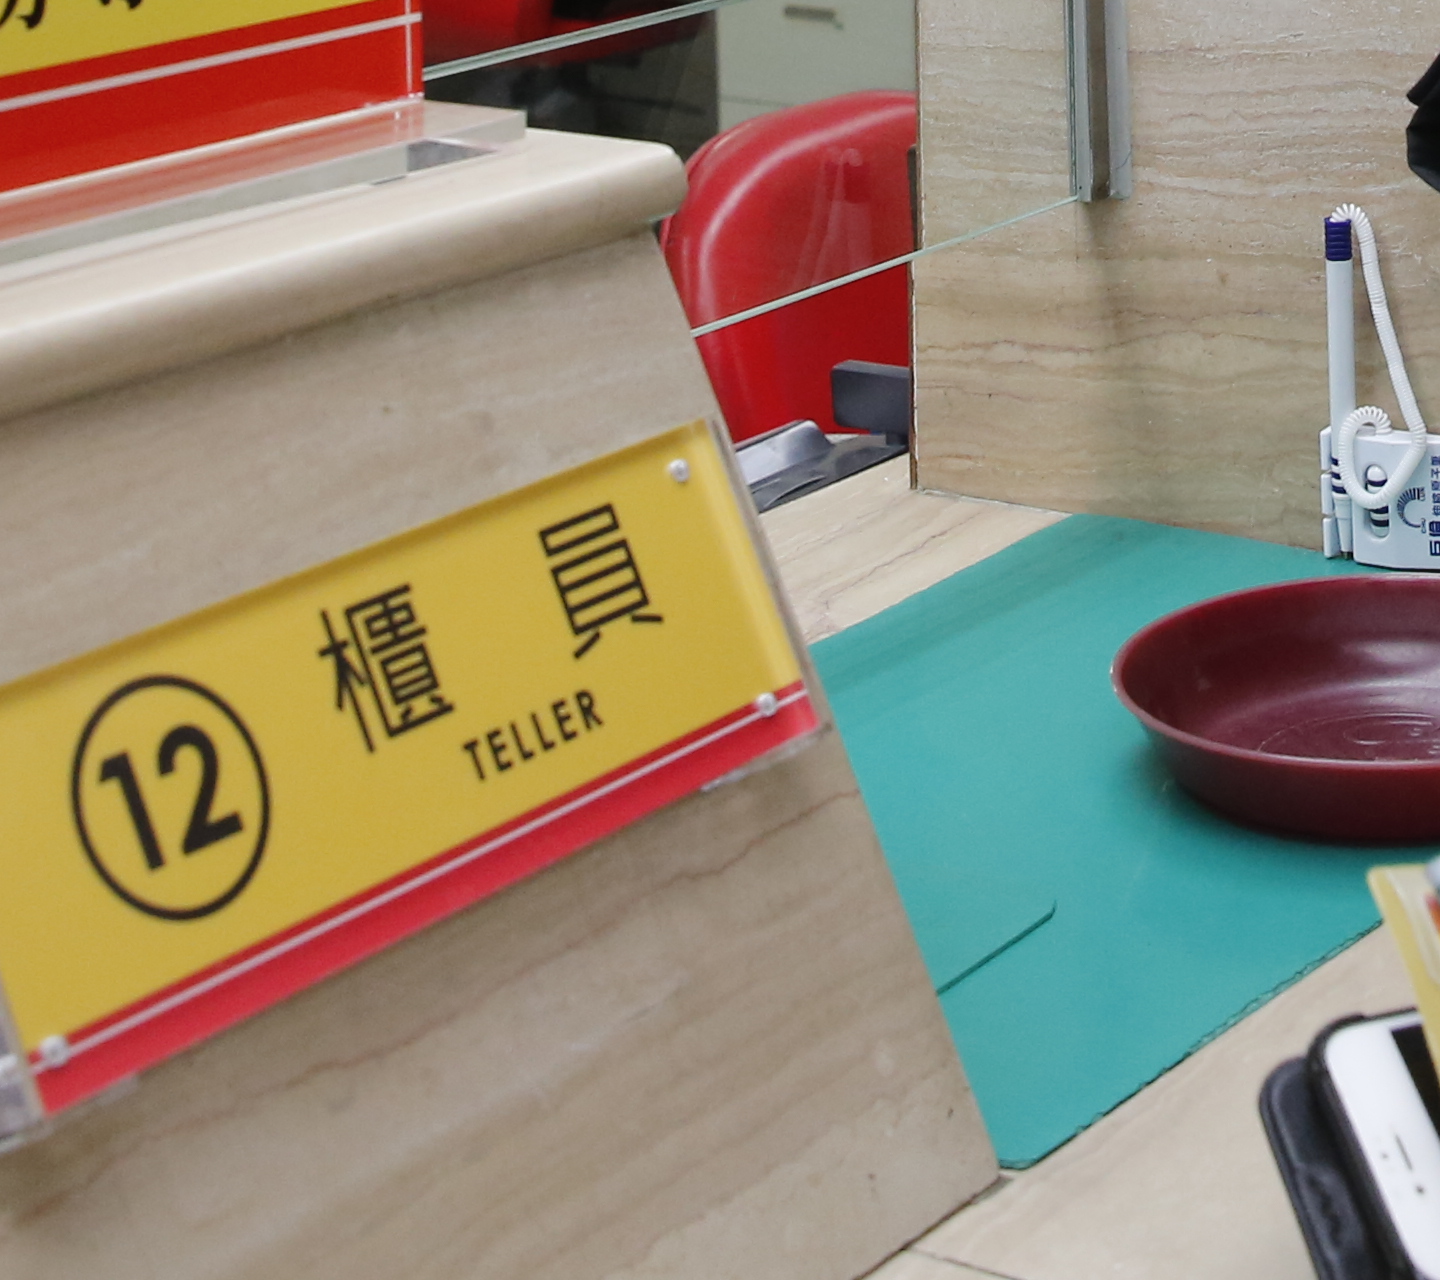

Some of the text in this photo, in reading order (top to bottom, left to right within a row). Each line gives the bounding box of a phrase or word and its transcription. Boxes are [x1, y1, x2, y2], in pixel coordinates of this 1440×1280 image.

[317, 502, 664, 754] 櫃員
[97, 724, 243, 873] 12
[462, 688, 603, 783] TELLER
